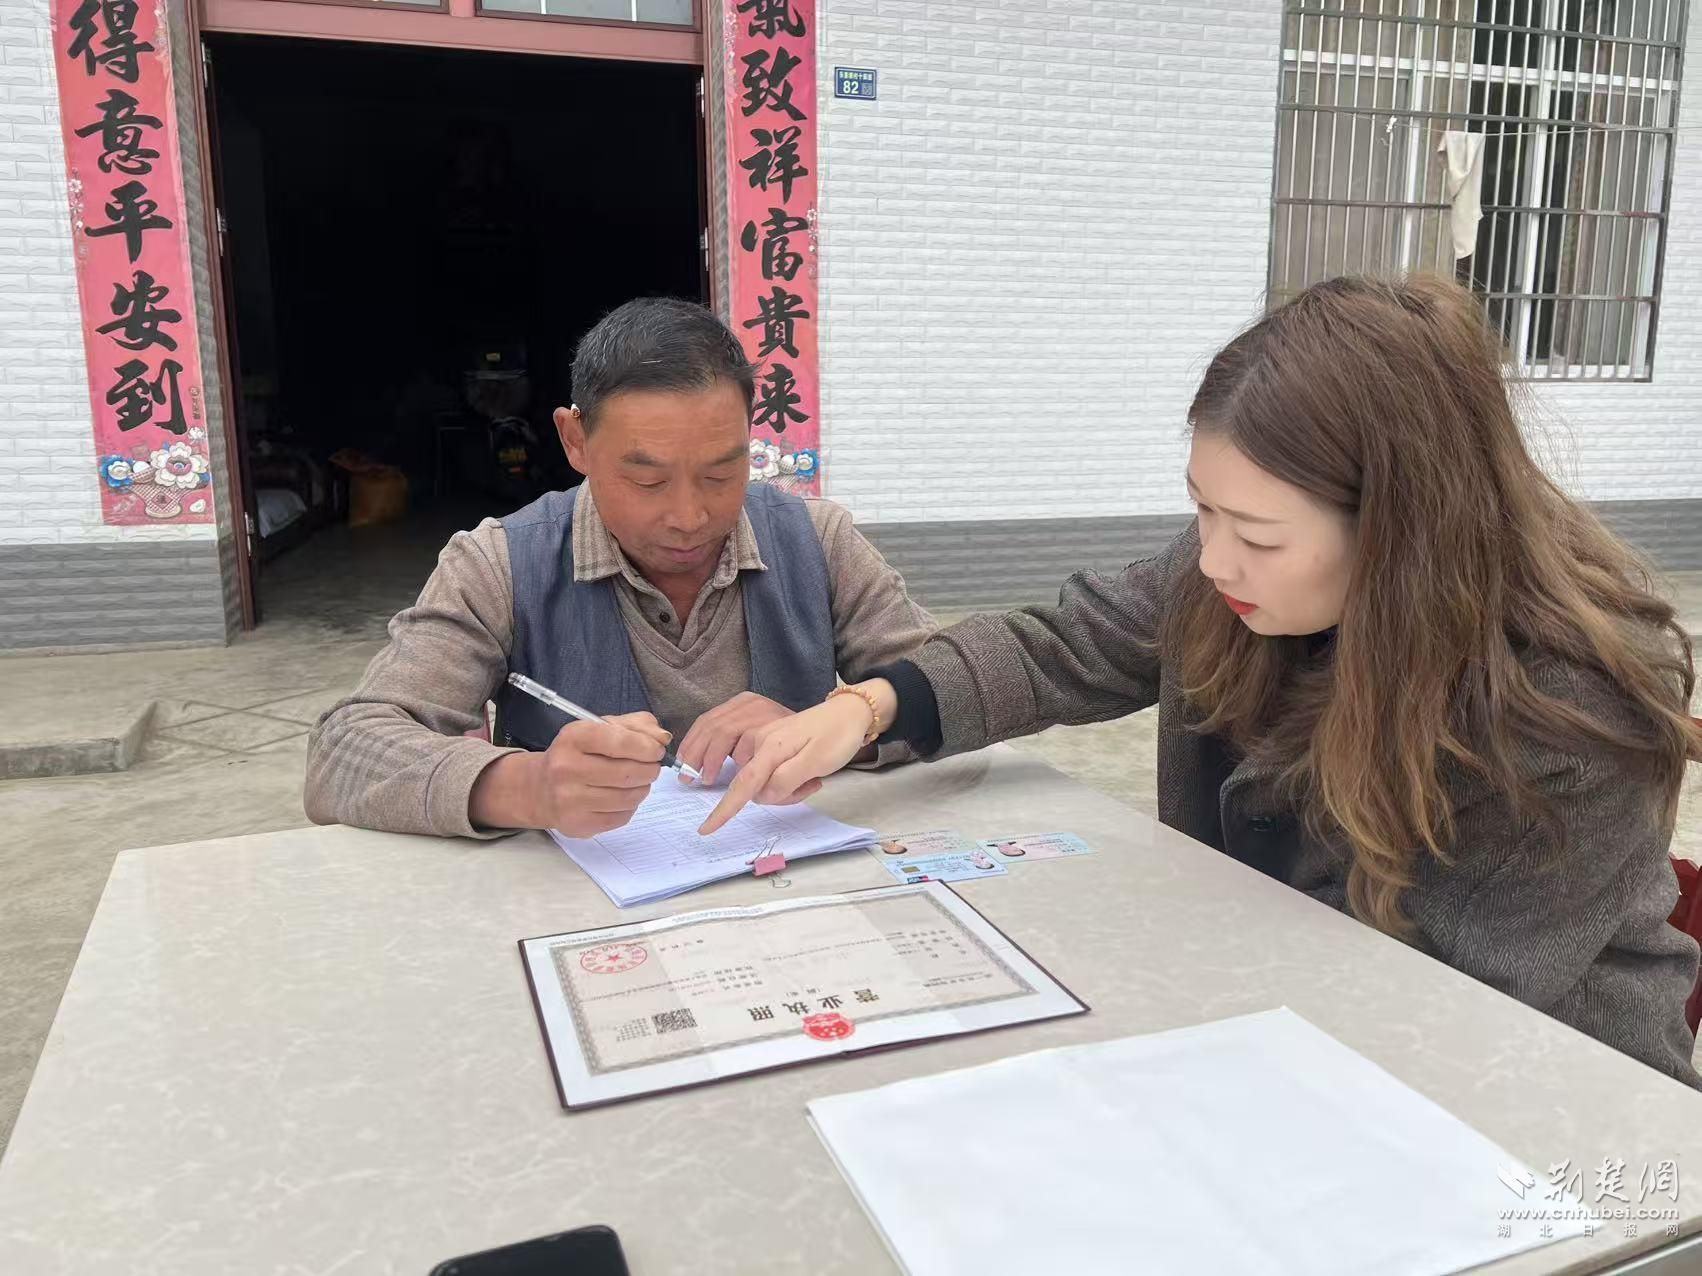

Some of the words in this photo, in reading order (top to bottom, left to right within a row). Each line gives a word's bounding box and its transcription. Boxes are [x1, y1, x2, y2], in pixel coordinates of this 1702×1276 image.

[843, 80, 859, 94] 82
[67, 0, 187, 435] 得意平安到
[747, 988, 879, 1022] 营业执照
